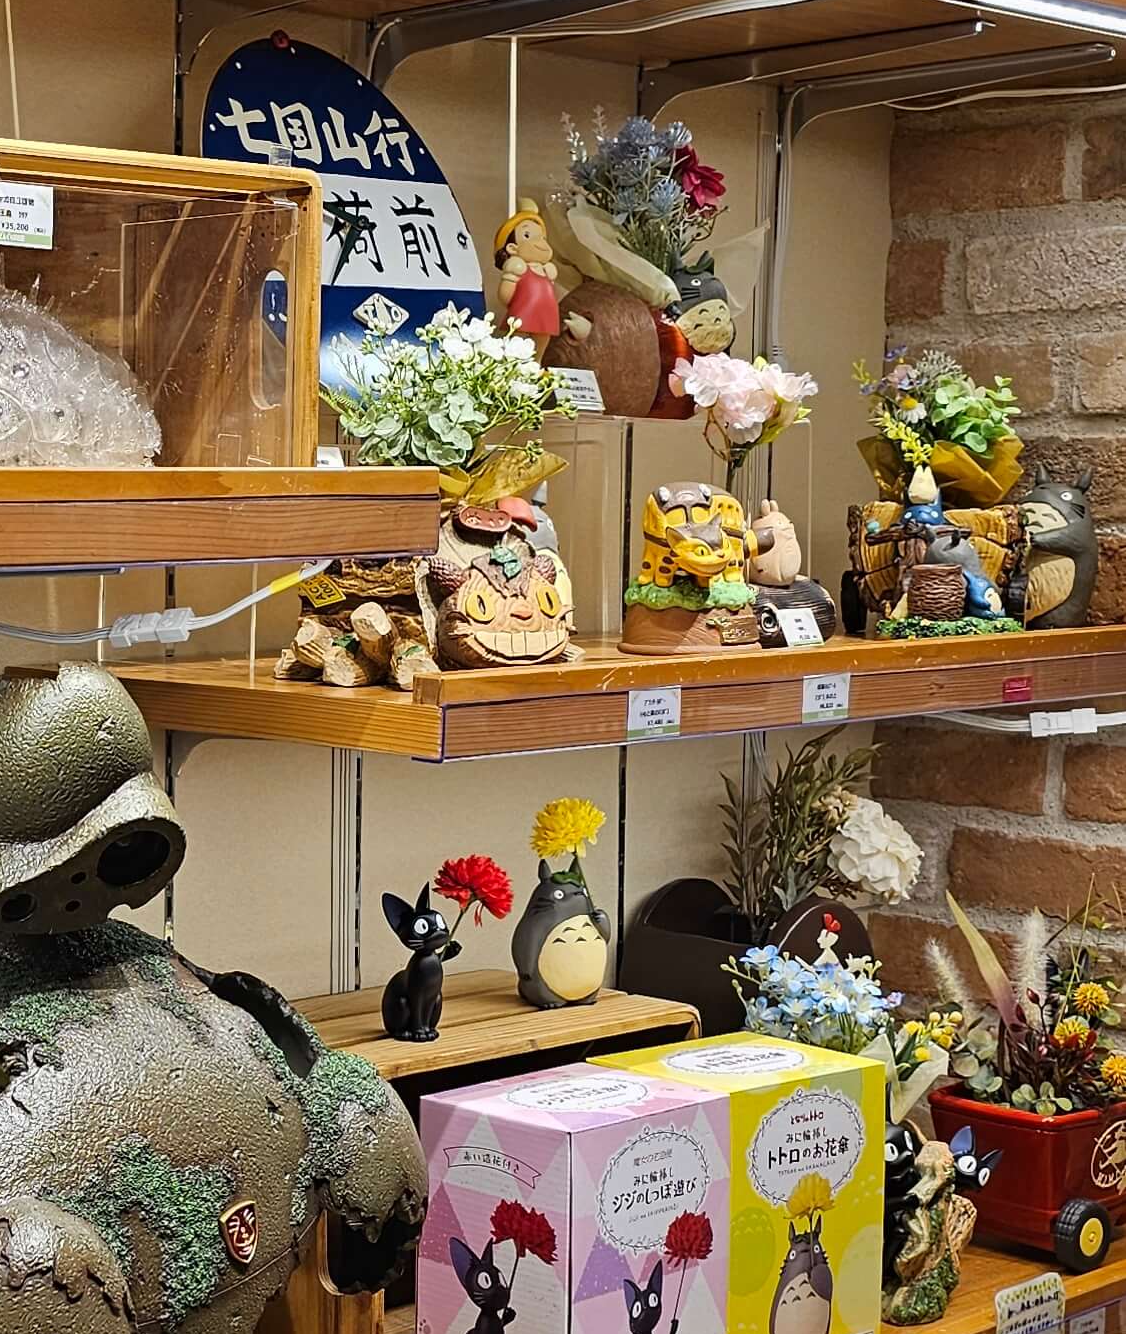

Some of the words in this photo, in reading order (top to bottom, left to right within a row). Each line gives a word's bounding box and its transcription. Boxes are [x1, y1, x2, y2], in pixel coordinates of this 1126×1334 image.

[215, 98, 416, 176] 七国山行
[768, 1135, 850, 1169] トトロのお花傘
[612, 1177, 697, 1214] ジジのしっぽ遊び
